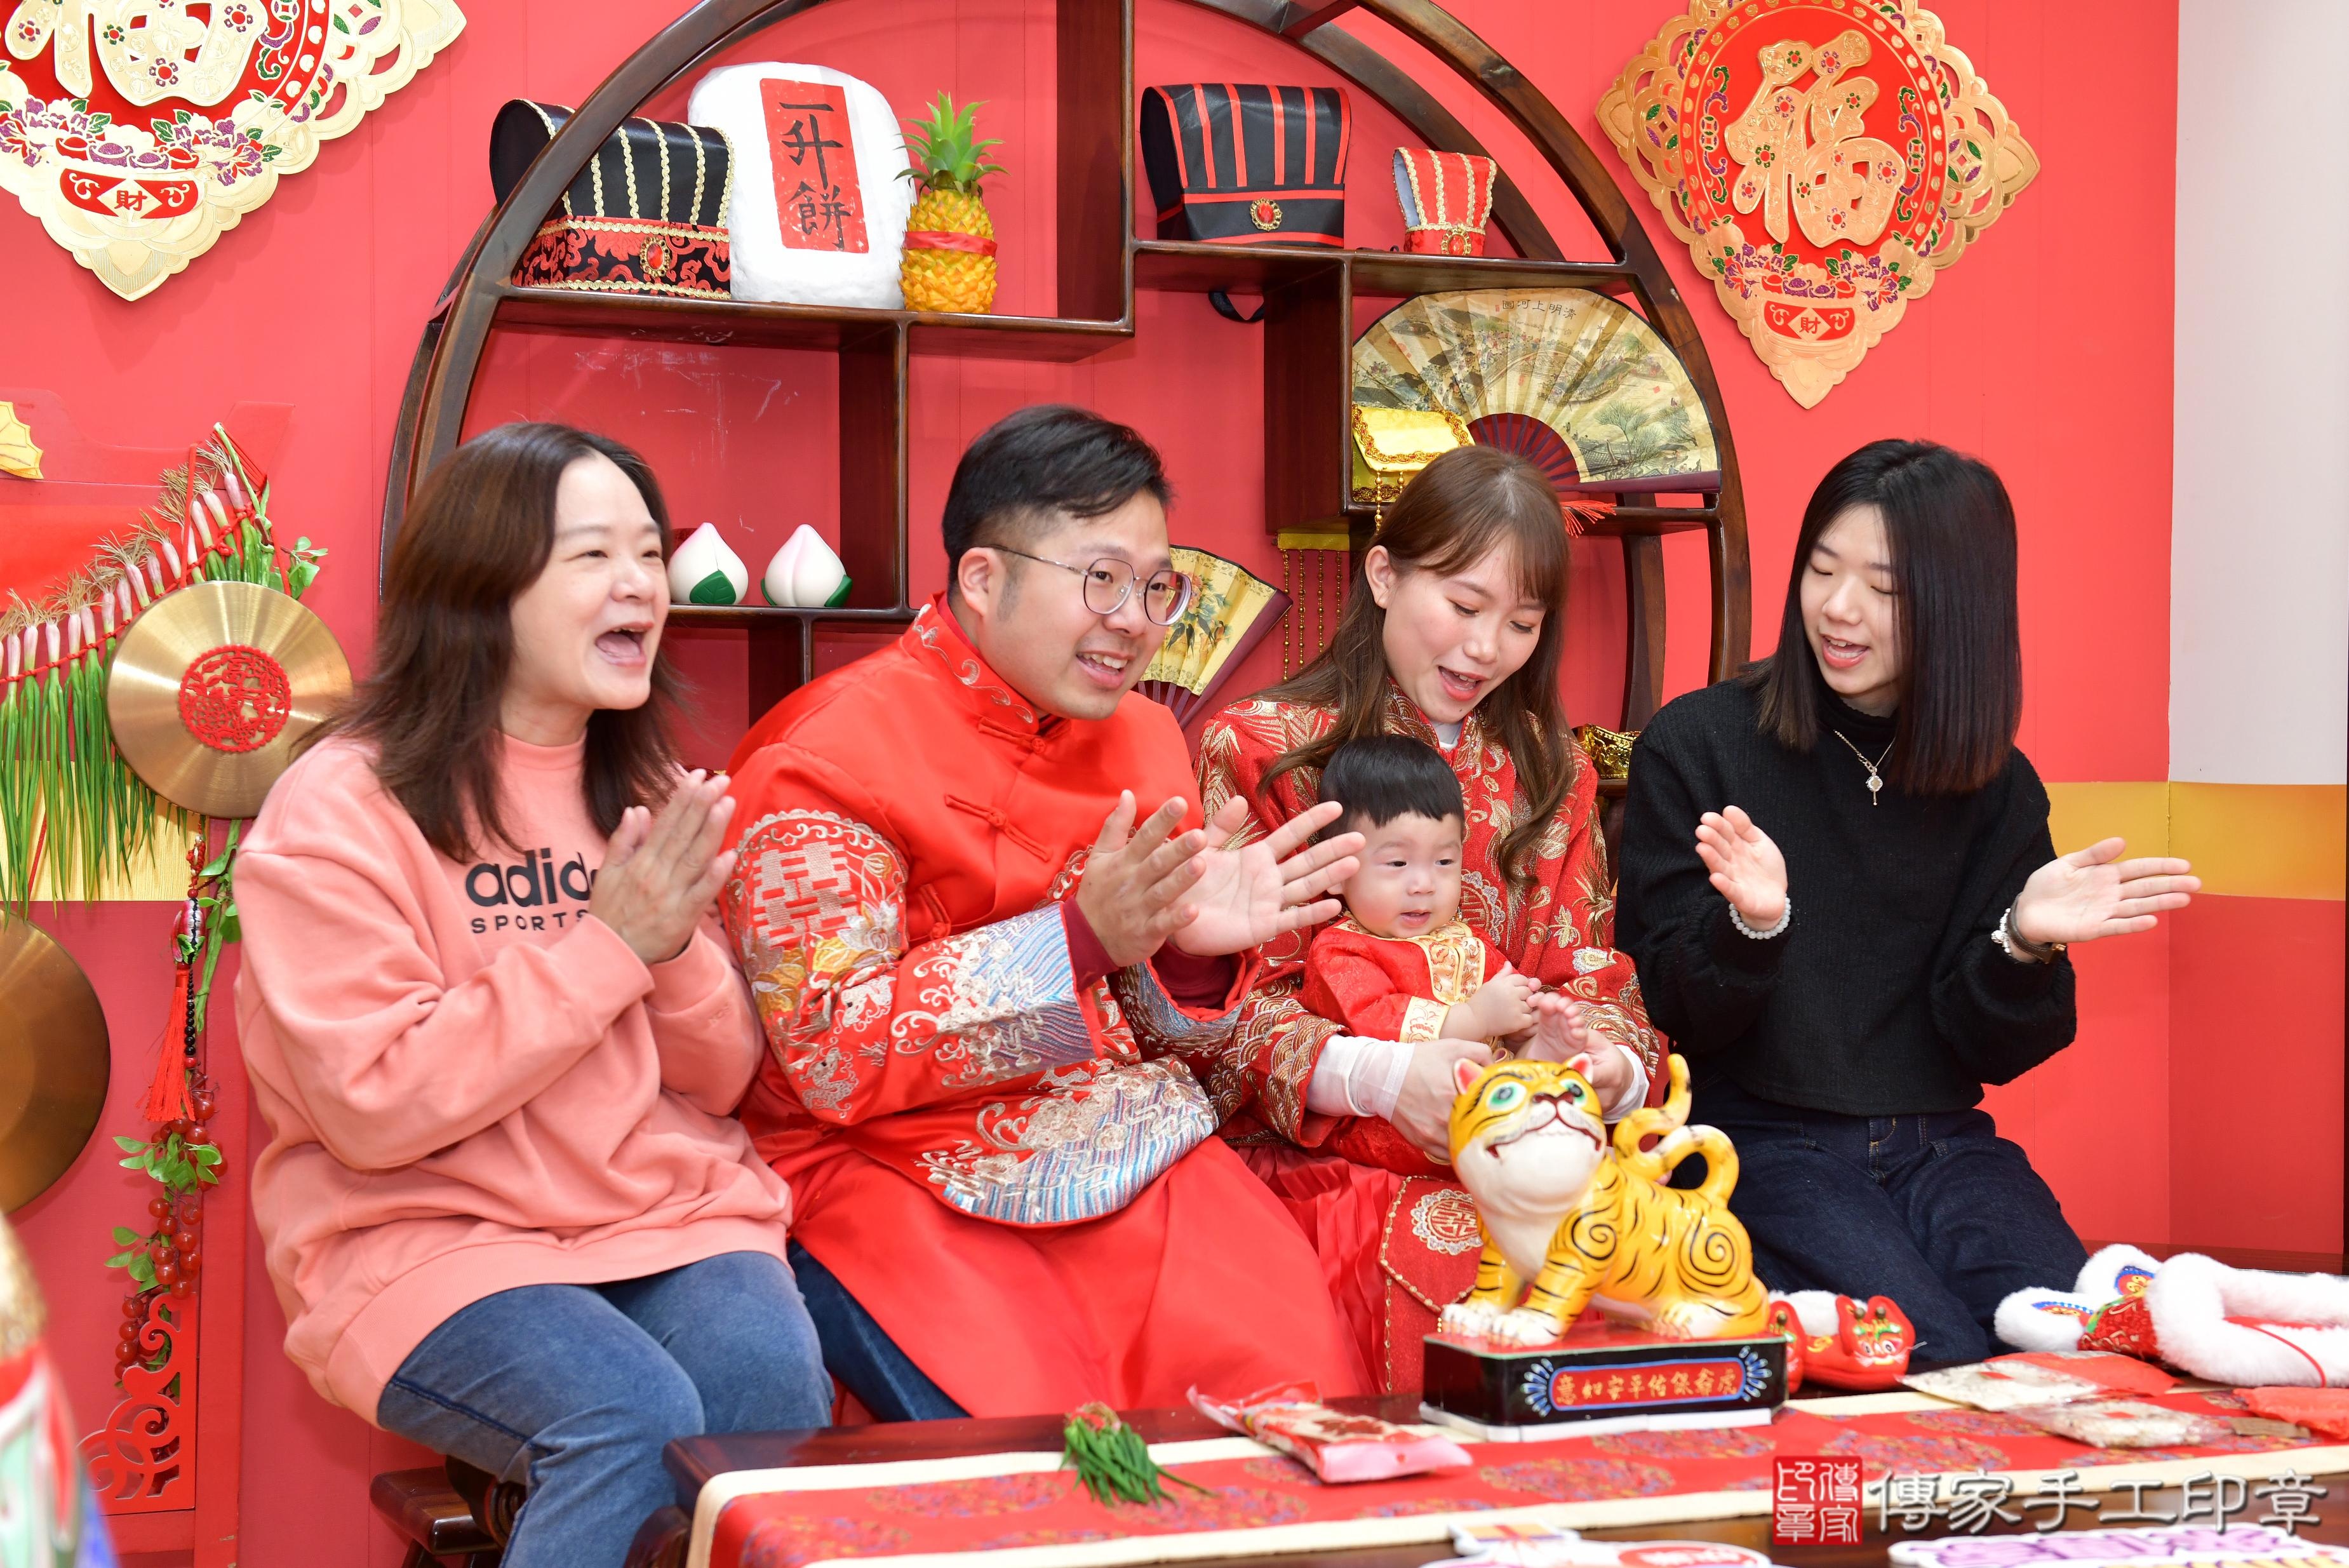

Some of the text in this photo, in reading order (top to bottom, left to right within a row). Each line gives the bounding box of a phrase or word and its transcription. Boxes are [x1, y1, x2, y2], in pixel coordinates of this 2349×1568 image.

[1724, 29, 1906, 248] 福
[115, 190, 148, 211] 財
[779, 102, 851, 251] 一升餅
[1799, 317, 1820, 334] 財
[465, 847, 599, 907] adid
